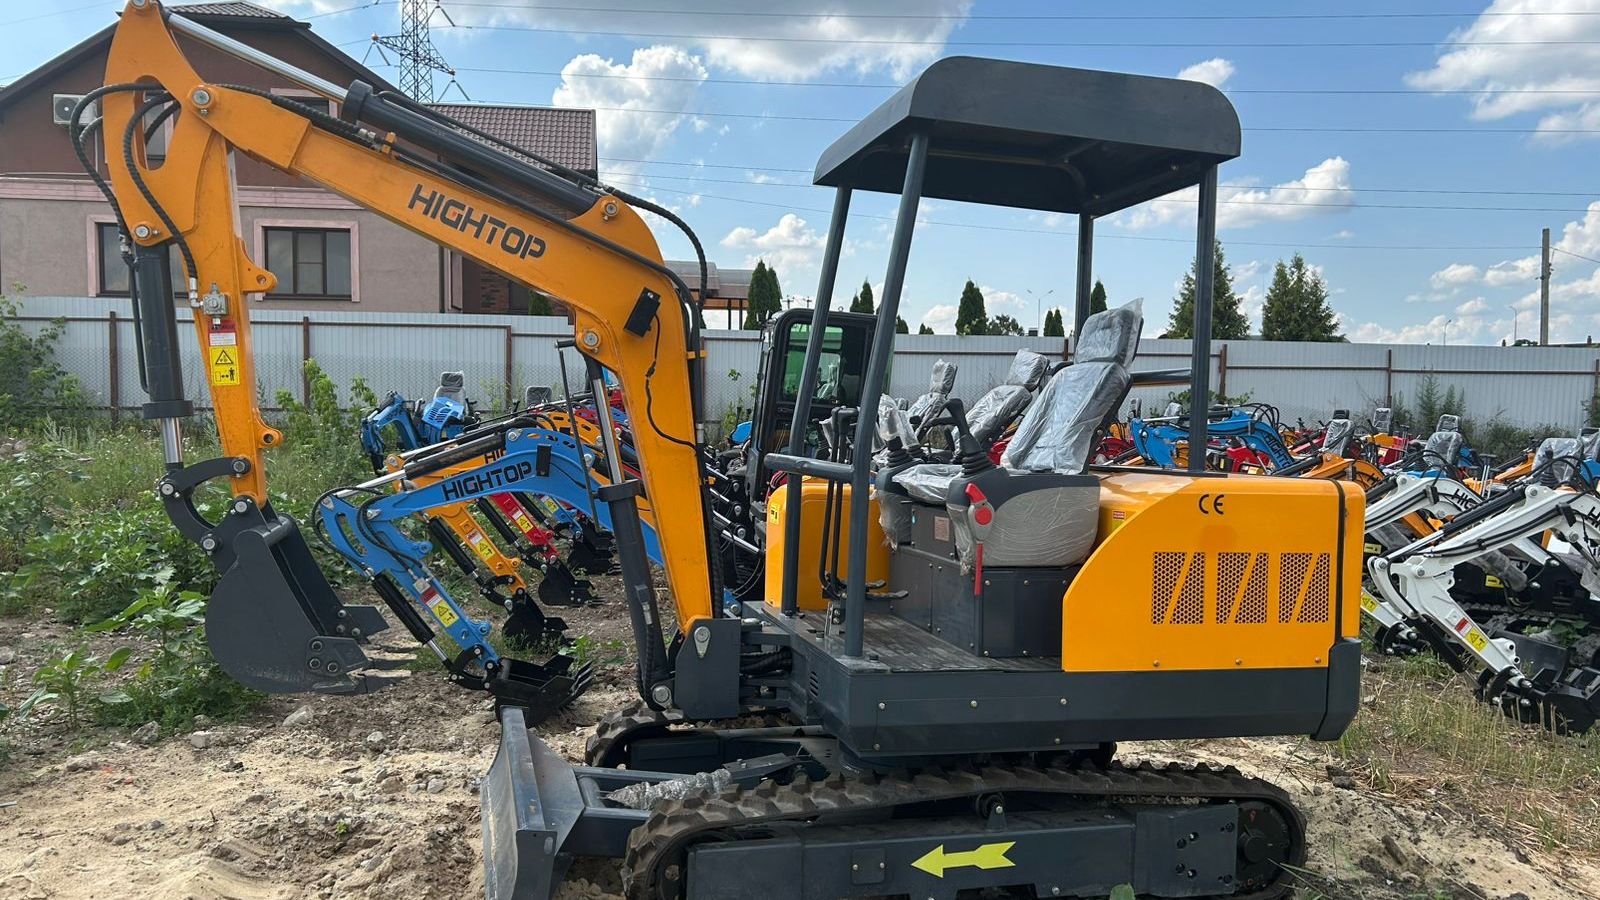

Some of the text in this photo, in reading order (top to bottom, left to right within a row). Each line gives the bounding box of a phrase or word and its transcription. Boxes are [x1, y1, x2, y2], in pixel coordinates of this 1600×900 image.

[408, 183, 546, 260] HIGHTOP
[441, 461, 532, 501] HIGHTOP
[1199, 494, 1224, 515] CE
